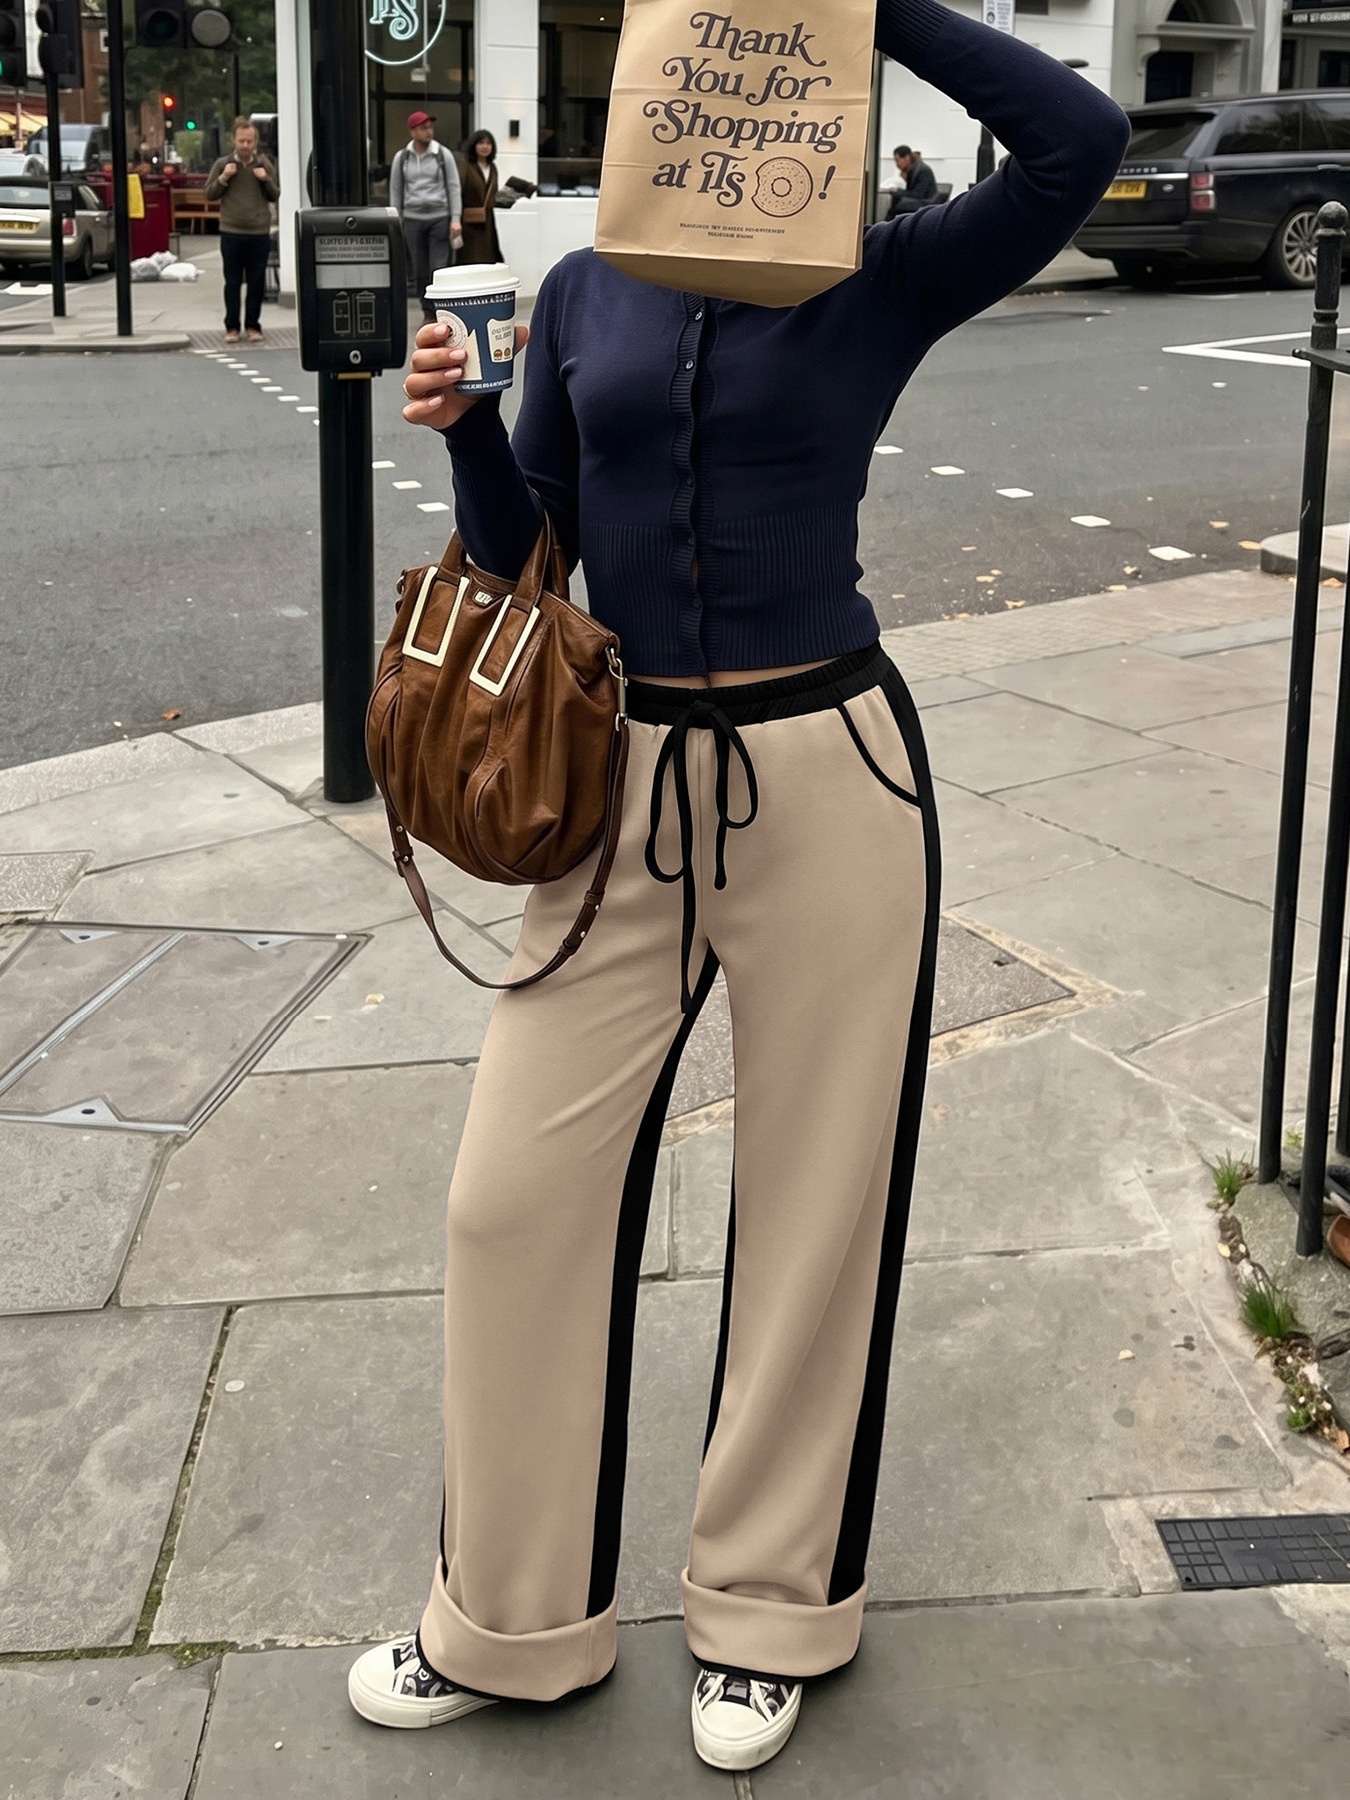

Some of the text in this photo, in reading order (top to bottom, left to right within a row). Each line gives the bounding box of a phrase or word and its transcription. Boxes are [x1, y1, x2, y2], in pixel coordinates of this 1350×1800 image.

[689, 11, 827, 67] Thank
[662, 56, 832, 107] You for
[642, 99, 844, 153] Shopping
[652, 158, 693, 188] at
